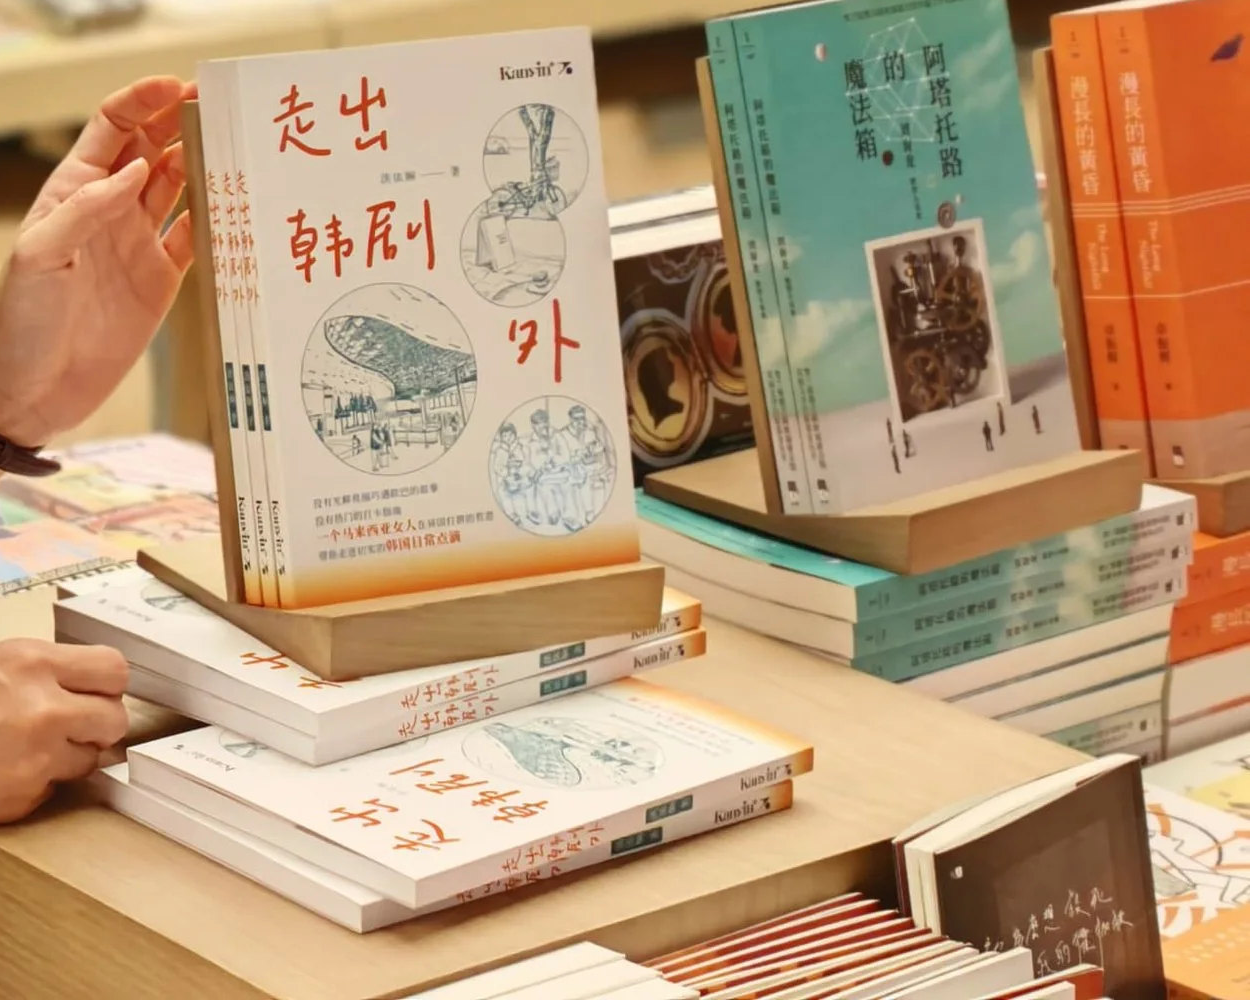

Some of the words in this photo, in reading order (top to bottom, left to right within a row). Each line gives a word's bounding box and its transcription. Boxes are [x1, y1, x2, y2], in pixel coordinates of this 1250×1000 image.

[883, 51, 906, 82] 的
[273, 76, 388, 156] 走出
[844, 61, 877, 161] 魔法箱
[923, 43, 963, 178] 阿塔托路
[287, 199, 435, 283] 韩剧
[509, 298, 580, 383] 外
[329, 798, 460, 851] 走出
[389, 758, 548, 823] 韩剧
